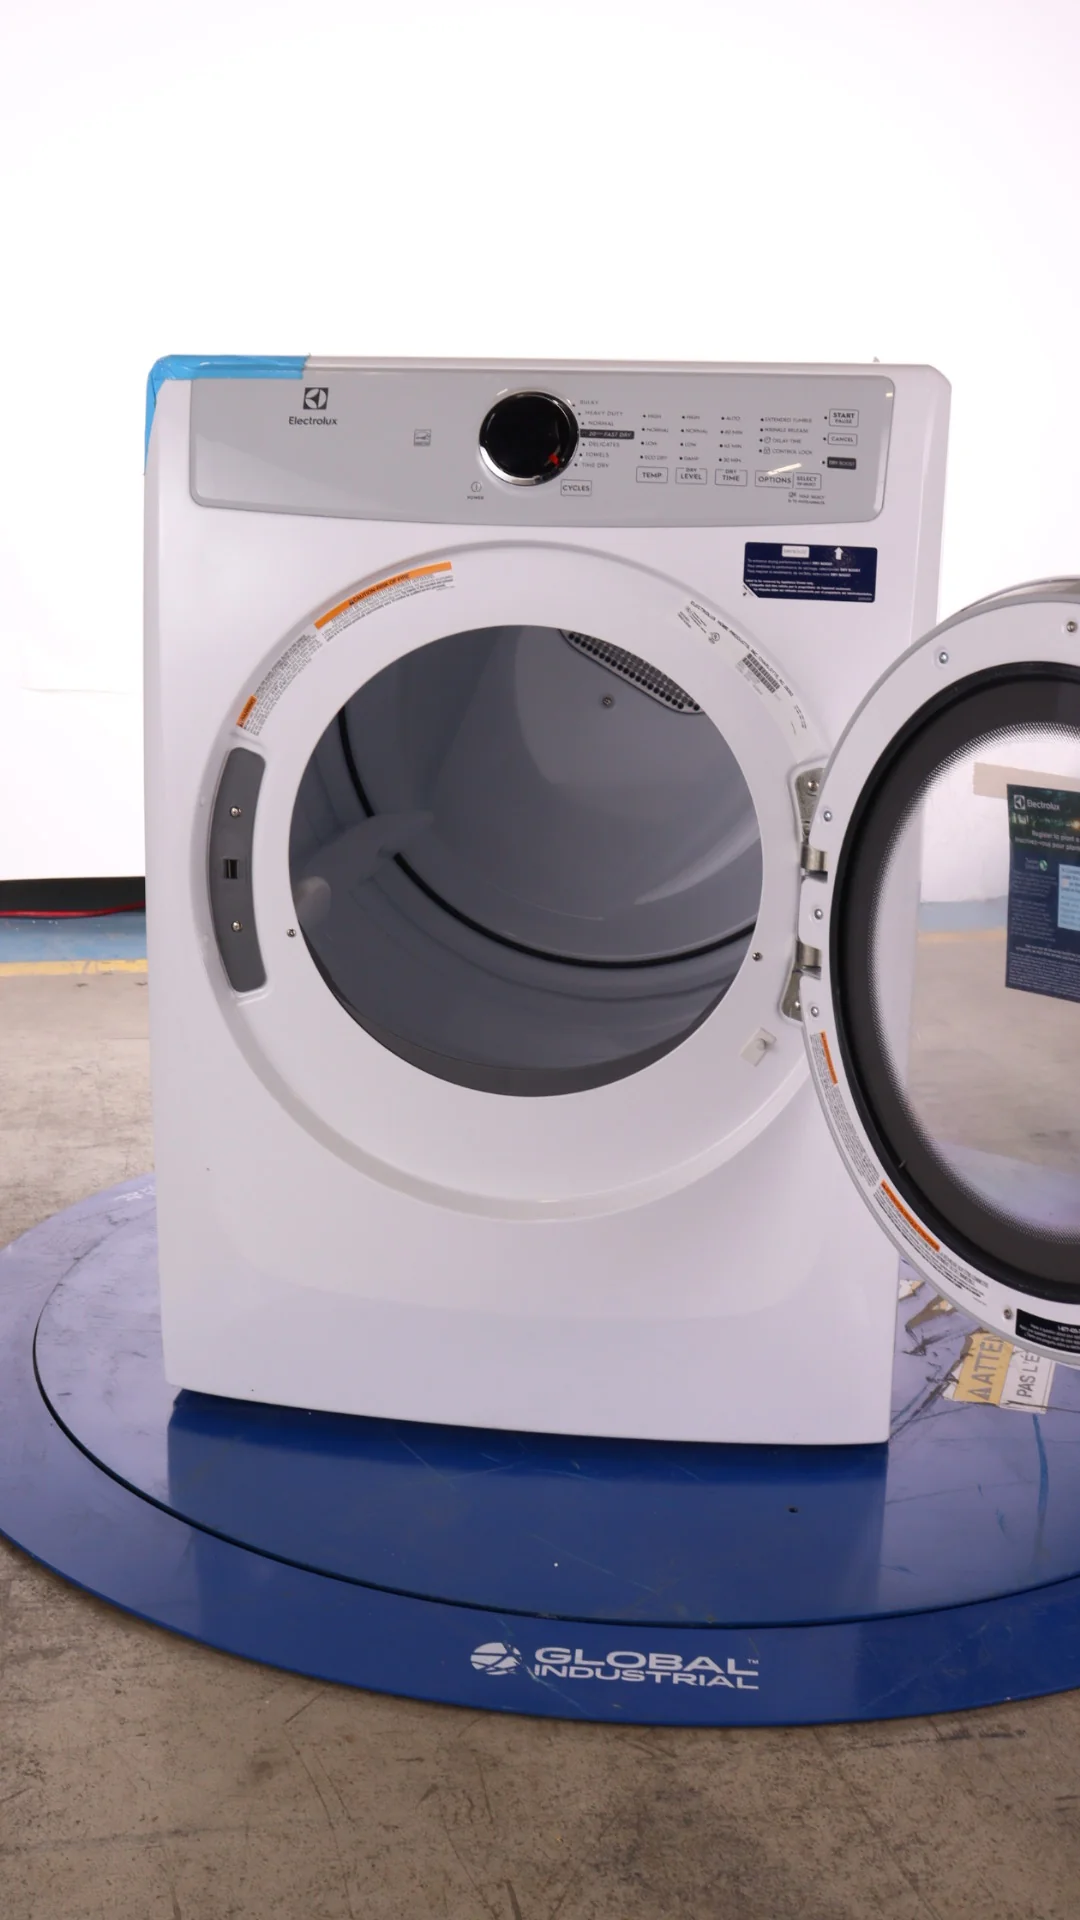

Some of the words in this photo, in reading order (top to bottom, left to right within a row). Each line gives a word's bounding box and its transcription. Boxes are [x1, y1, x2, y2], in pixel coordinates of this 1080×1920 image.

[288, 415, 338, 426] Electrolux
[642, 471, 662, 479] TEMP
[758, 476, 792, 484] OPTIONS
[1026, 799, 1060, 810] Electrolux
[1016, 1375, 1036, 1398] PAS
[535, 1647, 759, 1676] GLOBAL
[534, 1664, 759, 1690] INDUSTRIAL
